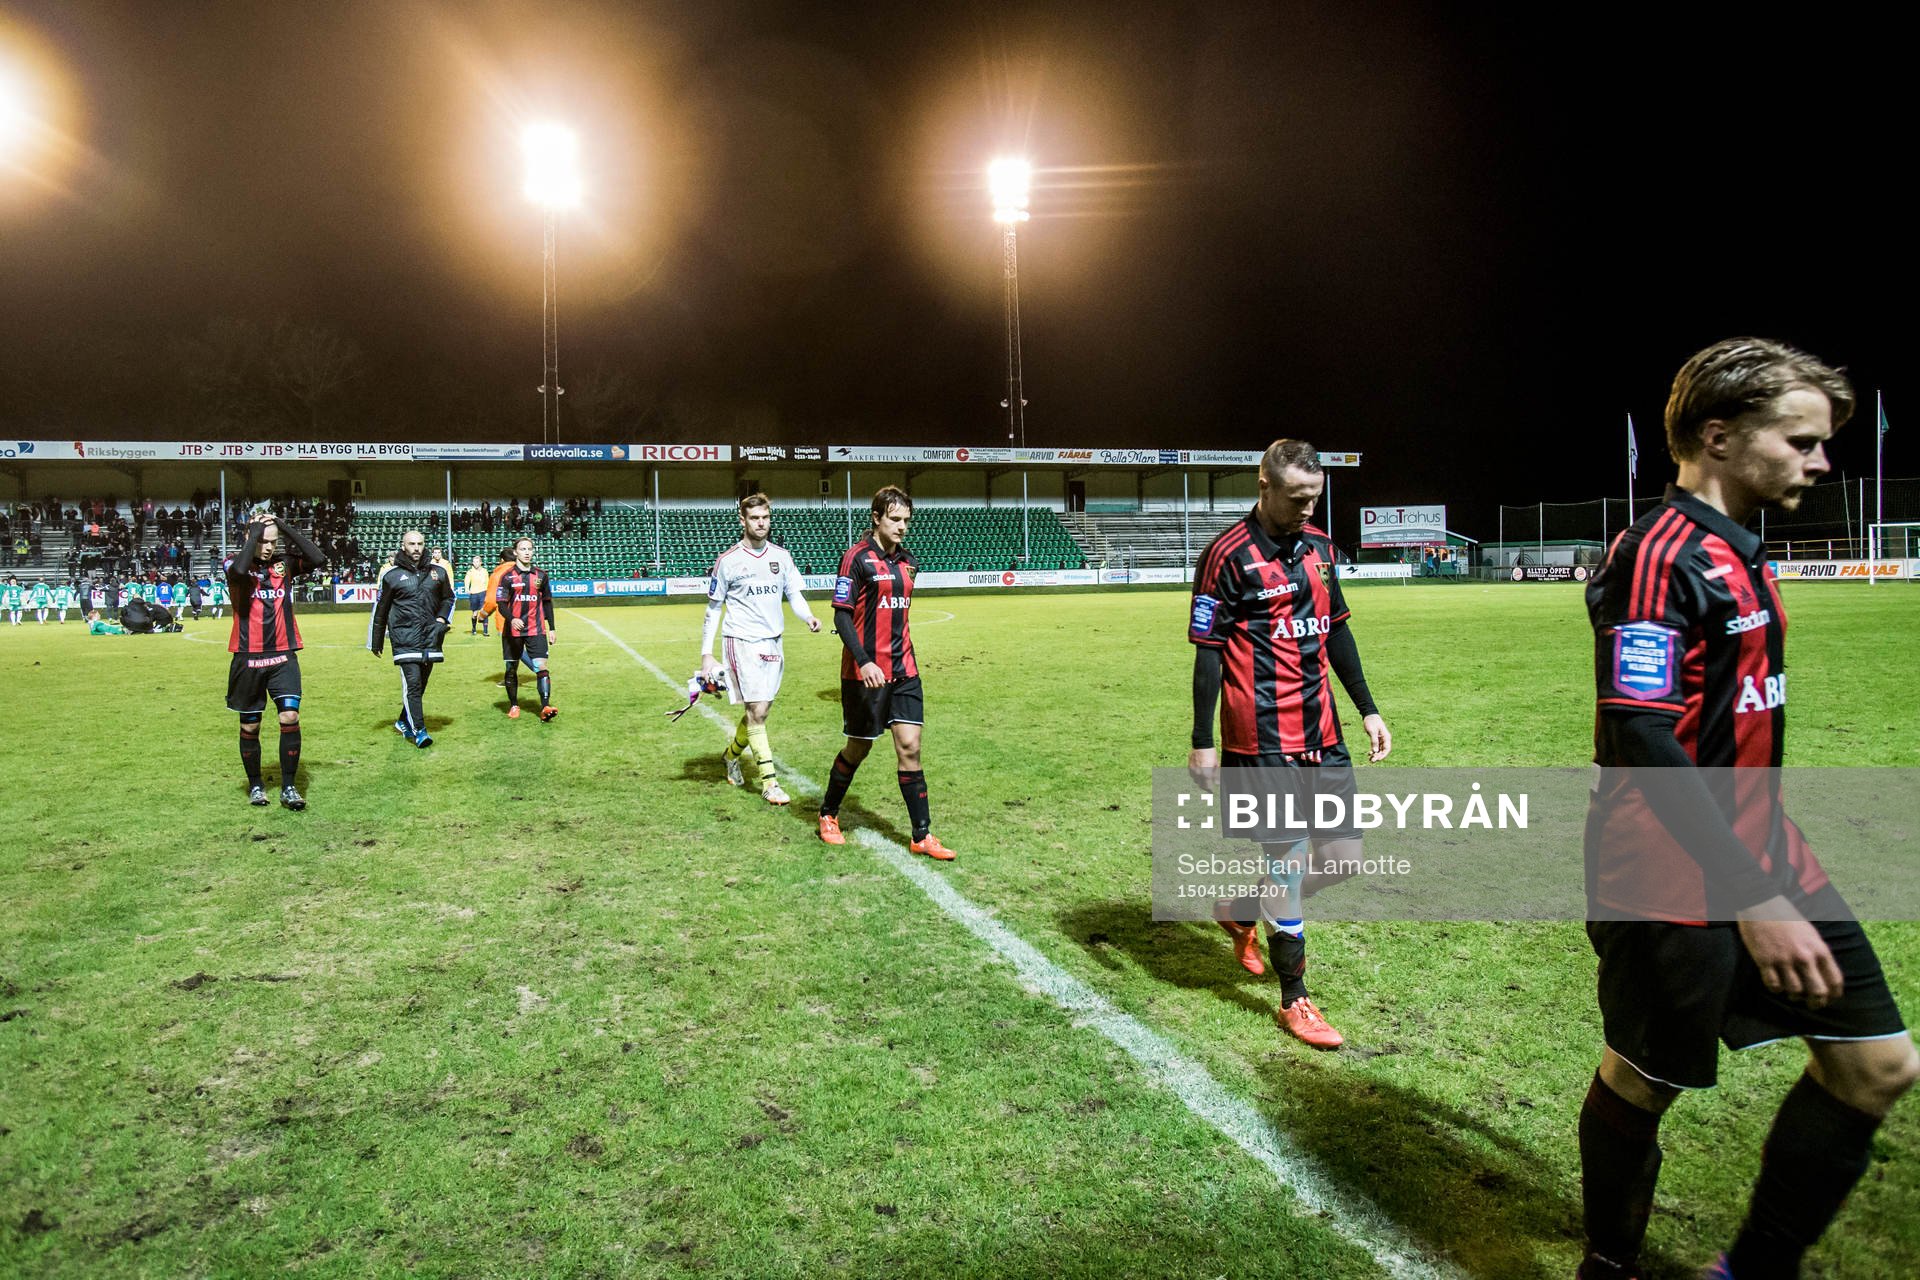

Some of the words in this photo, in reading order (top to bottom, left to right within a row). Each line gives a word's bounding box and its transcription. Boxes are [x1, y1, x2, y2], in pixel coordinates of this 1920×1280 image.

[87, 447, 156, 459] Riksbyggen
[179, 445, 202, 455] JTB
[220, 445, 243, 456] JTB
[260, 445, 283, 456] JTB
[298, 444, 317, 454] H.A
[320, 444, 352, 454] BYGG
[357, 444, 376, 454] H.A
[379, 444, 410, 454] BYGG
[530, 448, 604, 459] uddevalla.se
[642, 446, 719, 460] RICOH
[923, 450, 955, 460] COMFORT
[1057, 451, 1093, 459] FJÄRAS
[1029, 452, 1054, 461] ARVID
[1100, 451, 1127, 463] Bella
[1127, 451, 1156, 463] Mare
[354, 481, 362, 494] A
[1364, 508, 1441, 525] DalaTrähus
[1780, 564, 1801, 574] STARKE
[1800, 564, 1837, 577] ARVID
[968, 574, 1000, 584] COMFORT
[607, 581, 664, 593] STRYKTIPSET
[746, 584, 778, 596] ÅBRO
[1258, 582, 1299, 601] stadium
[878, 595, 911, 609] ÅBRO
[1271, 615, 1331, 640] ÅBRO
